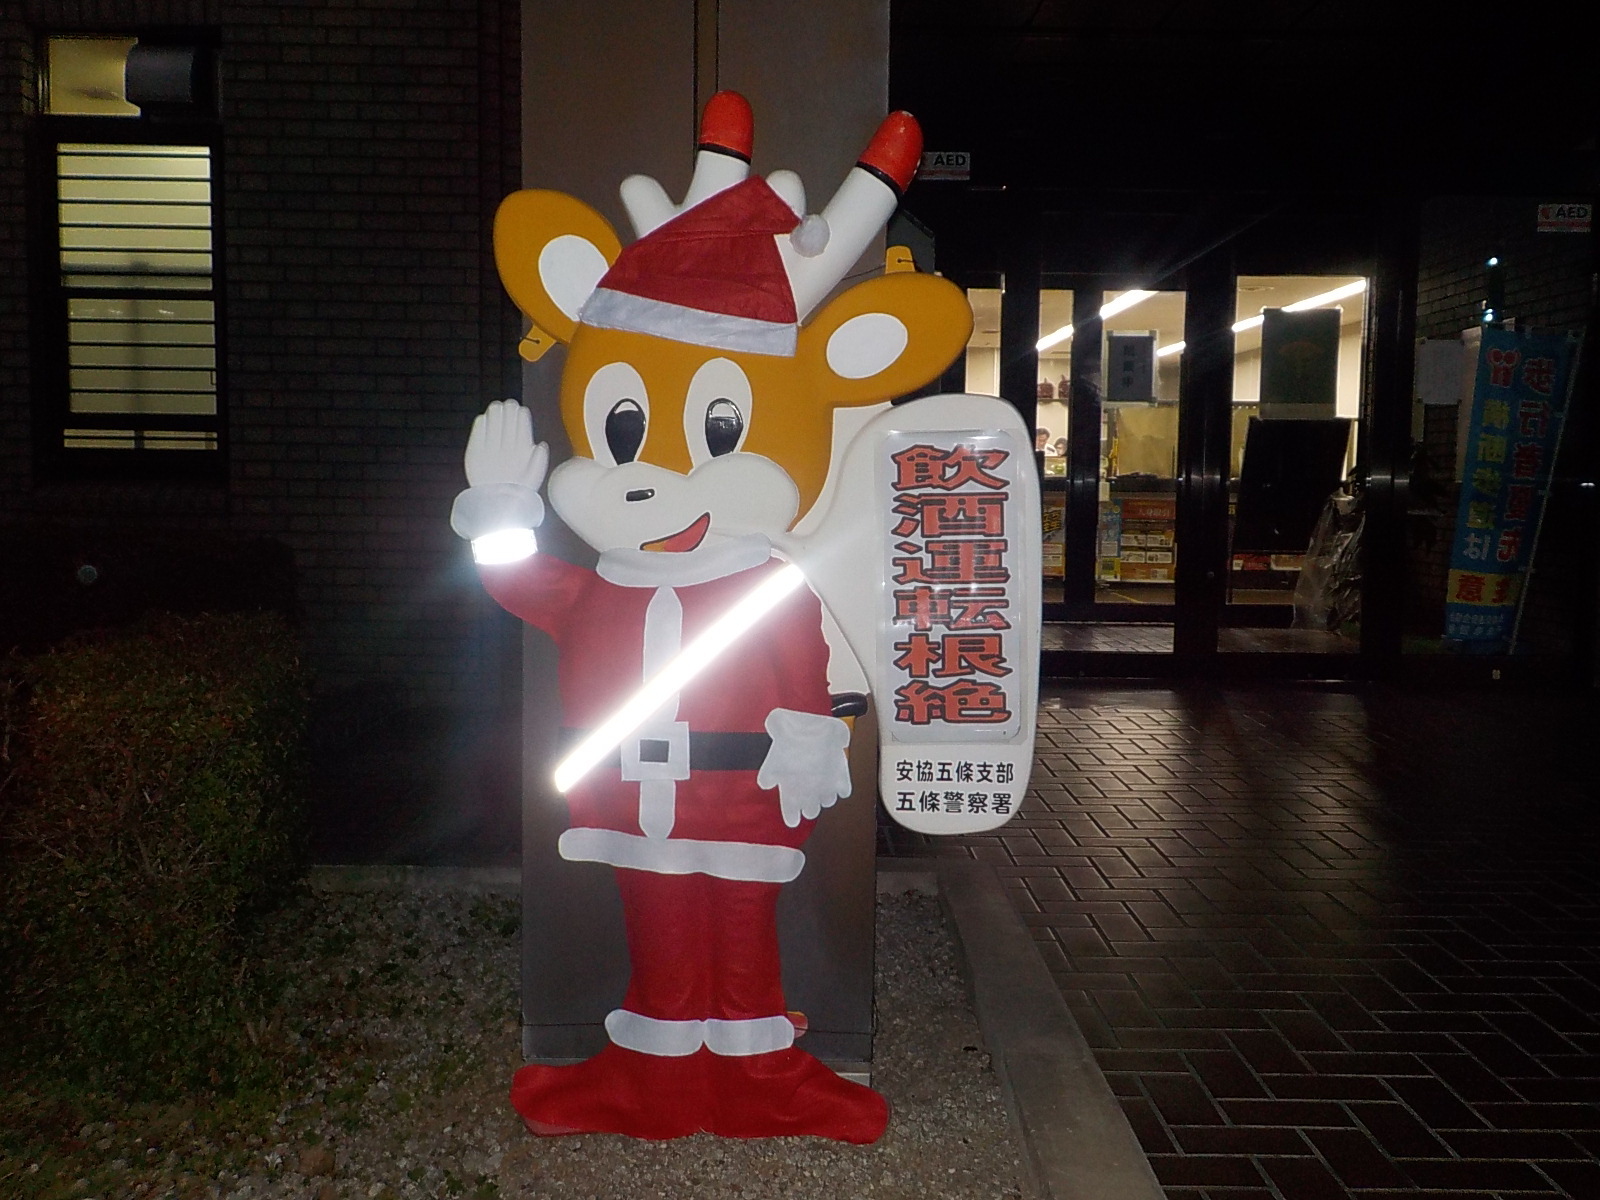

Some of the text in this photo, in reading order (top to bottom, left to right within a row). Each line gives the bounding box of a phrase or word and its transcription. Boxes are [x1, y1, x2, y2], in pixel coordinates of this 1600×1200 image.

[933, 153, 967, 167] AED
[1555, 205, 1589, 219] AED
[891, 444, 1012, 725] 飲酒運転根絶
[896, 759, 1015, 784] 安協五條支部
[895, 790, 1013, 814] 五條警察署
